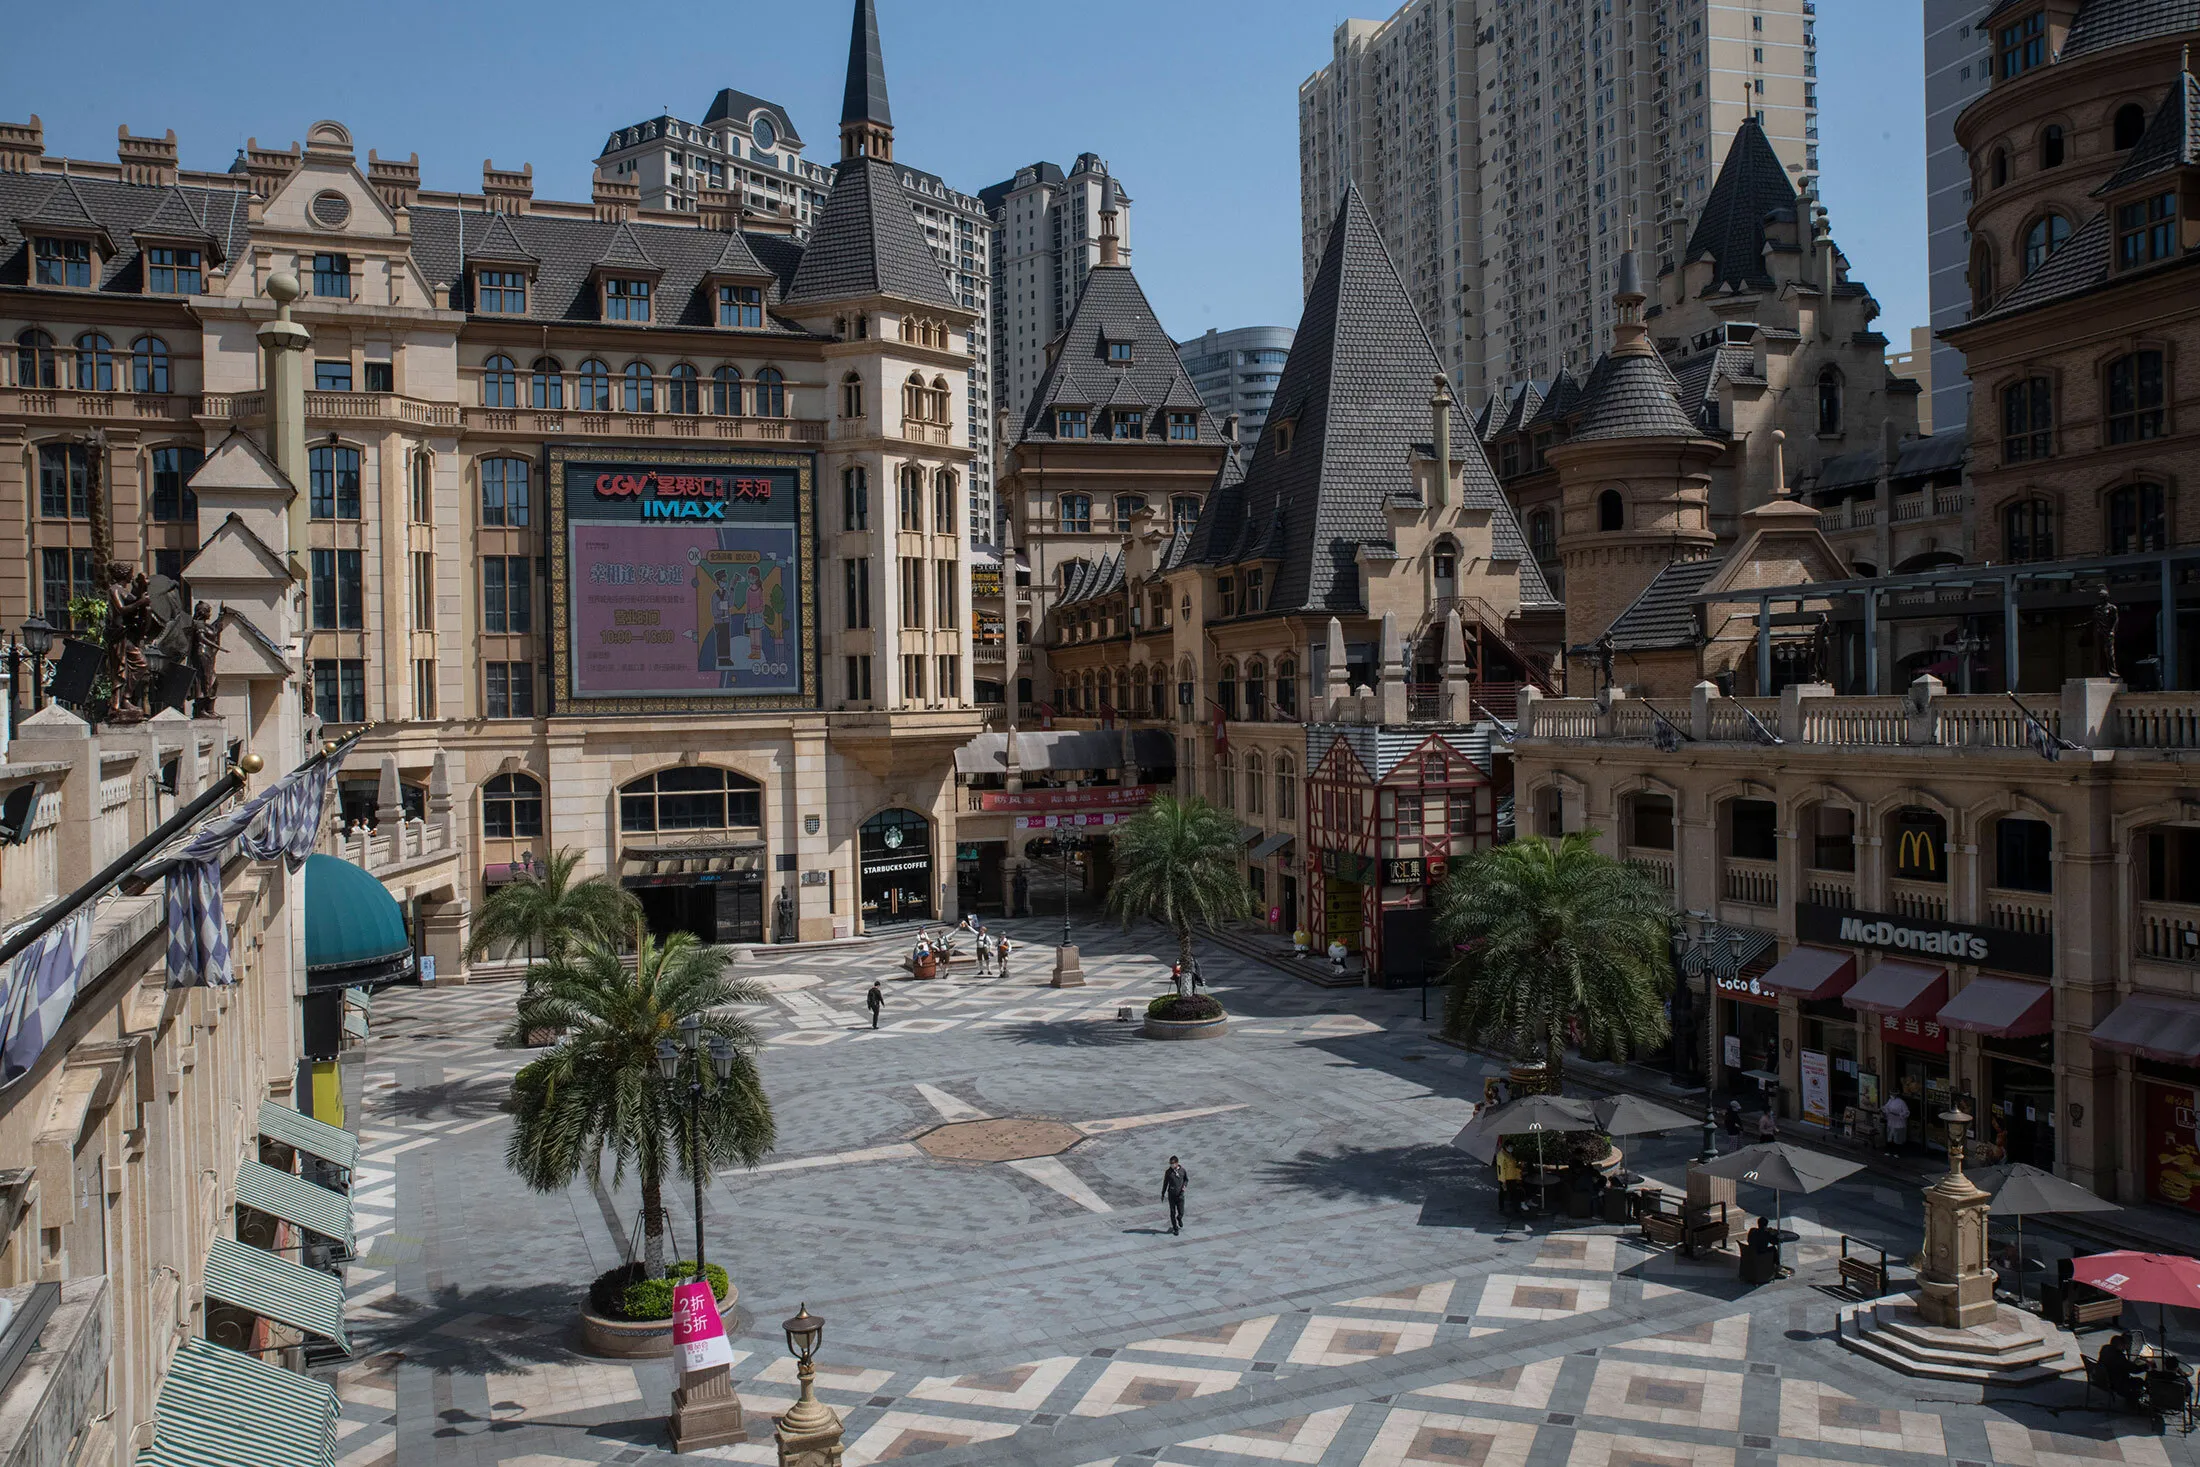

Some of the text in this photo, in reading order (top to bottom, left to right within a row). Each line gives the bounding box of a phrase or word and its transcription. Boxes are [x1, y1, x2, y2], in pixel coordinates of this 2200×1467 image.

[596, 474, 647, 496] CGV
[736, 479, 771, 498] 天河
[644, 500, 725, 519] IMAX
[614, 609, 661, 626] 营业时间
[864, 861, 928, 875] STARBUCKS COFFEE
[1839, 916, 1989, 960] McDonald's
[1883, 1015, 1941, 1039] 麦当劳
[680, 1294, 706, 1313] 2折
[683, 1314, 709, 1335] 5折
